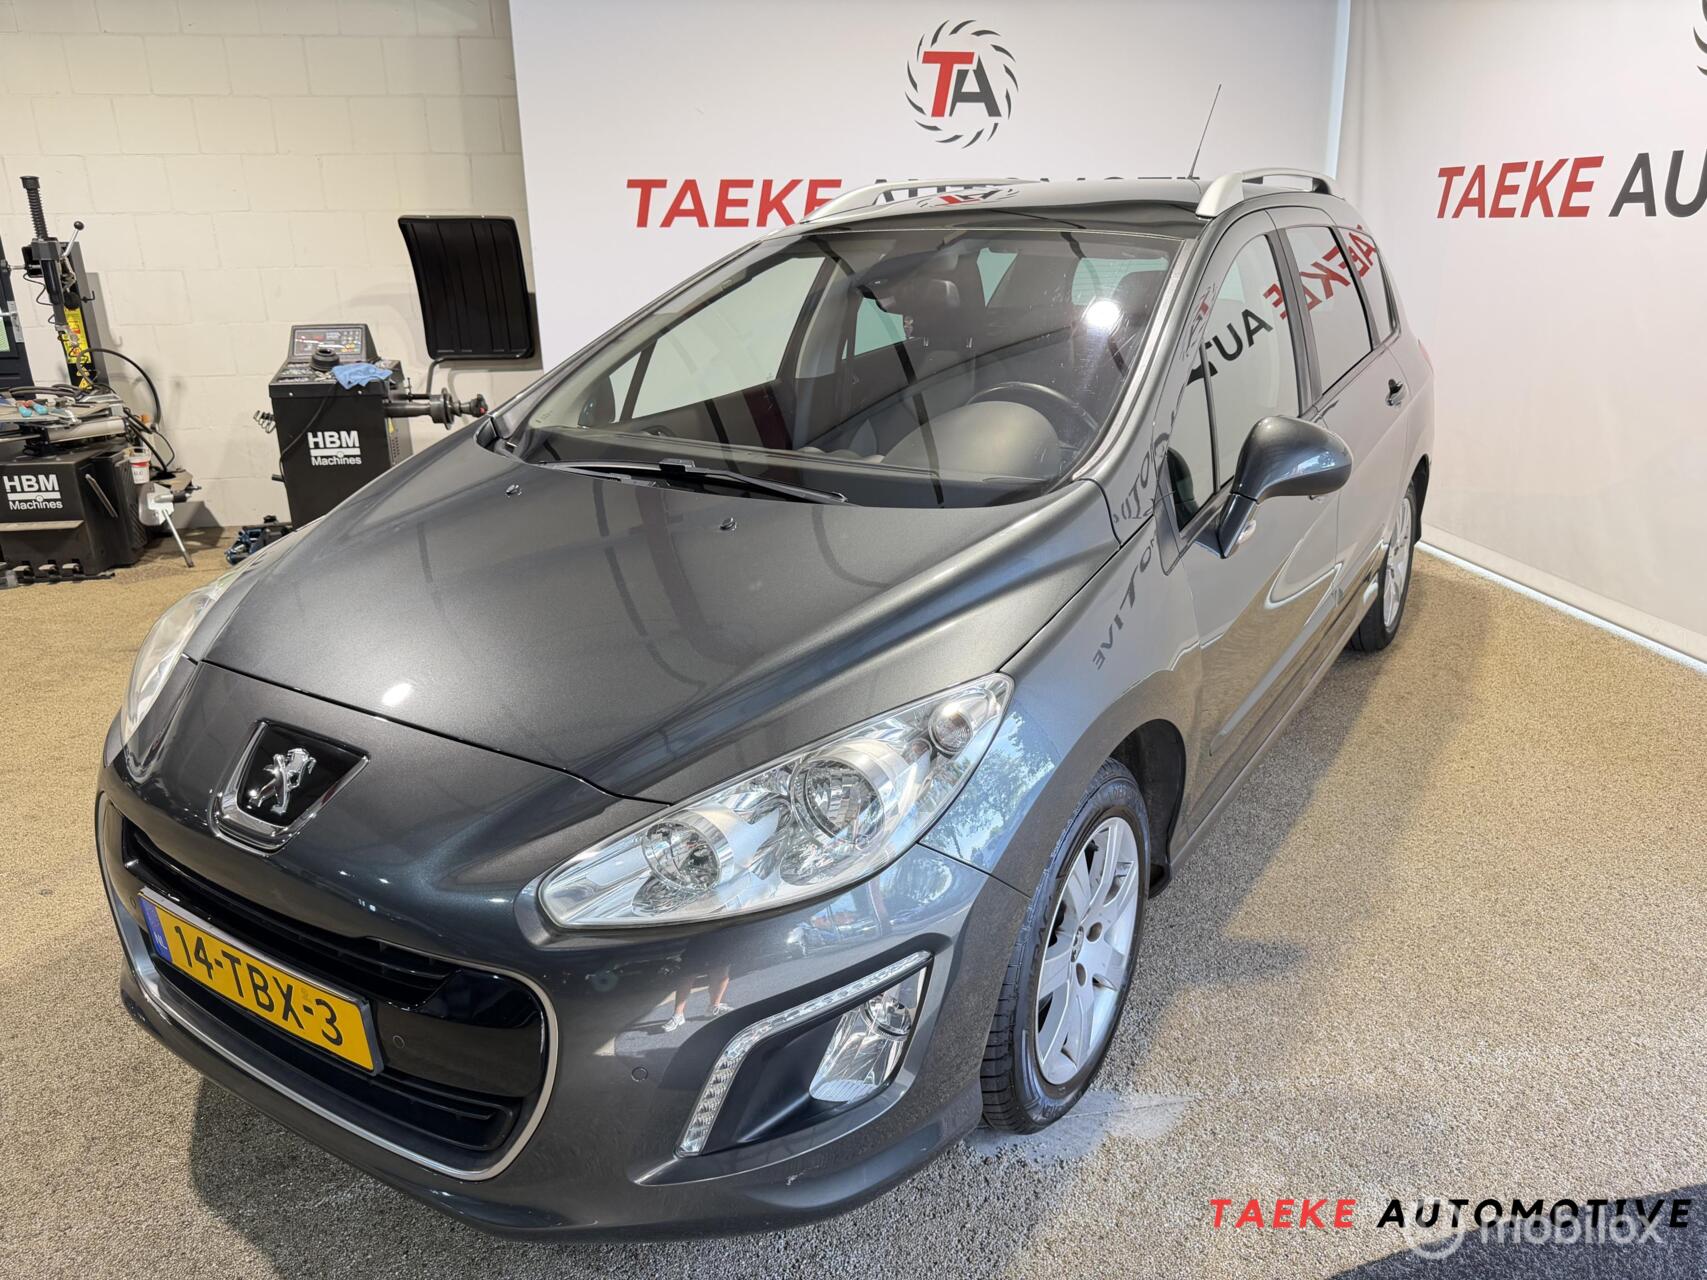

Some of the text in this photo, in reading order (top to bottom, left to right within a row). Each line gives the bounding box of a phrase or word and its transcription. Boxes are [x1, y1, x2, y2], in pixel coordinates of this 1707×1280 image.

[921, 50, 1003, 118] TA
[1436, 156, 1605, 219] TAEKE
[307, 430, 360, 448] HBM
[311, 455, 362, 467] Machines
[2, 474, 60, 493] HBM
[9, 499, 63, 511] Machines
[174, 925, 344, 1047] 14-TBX-3
